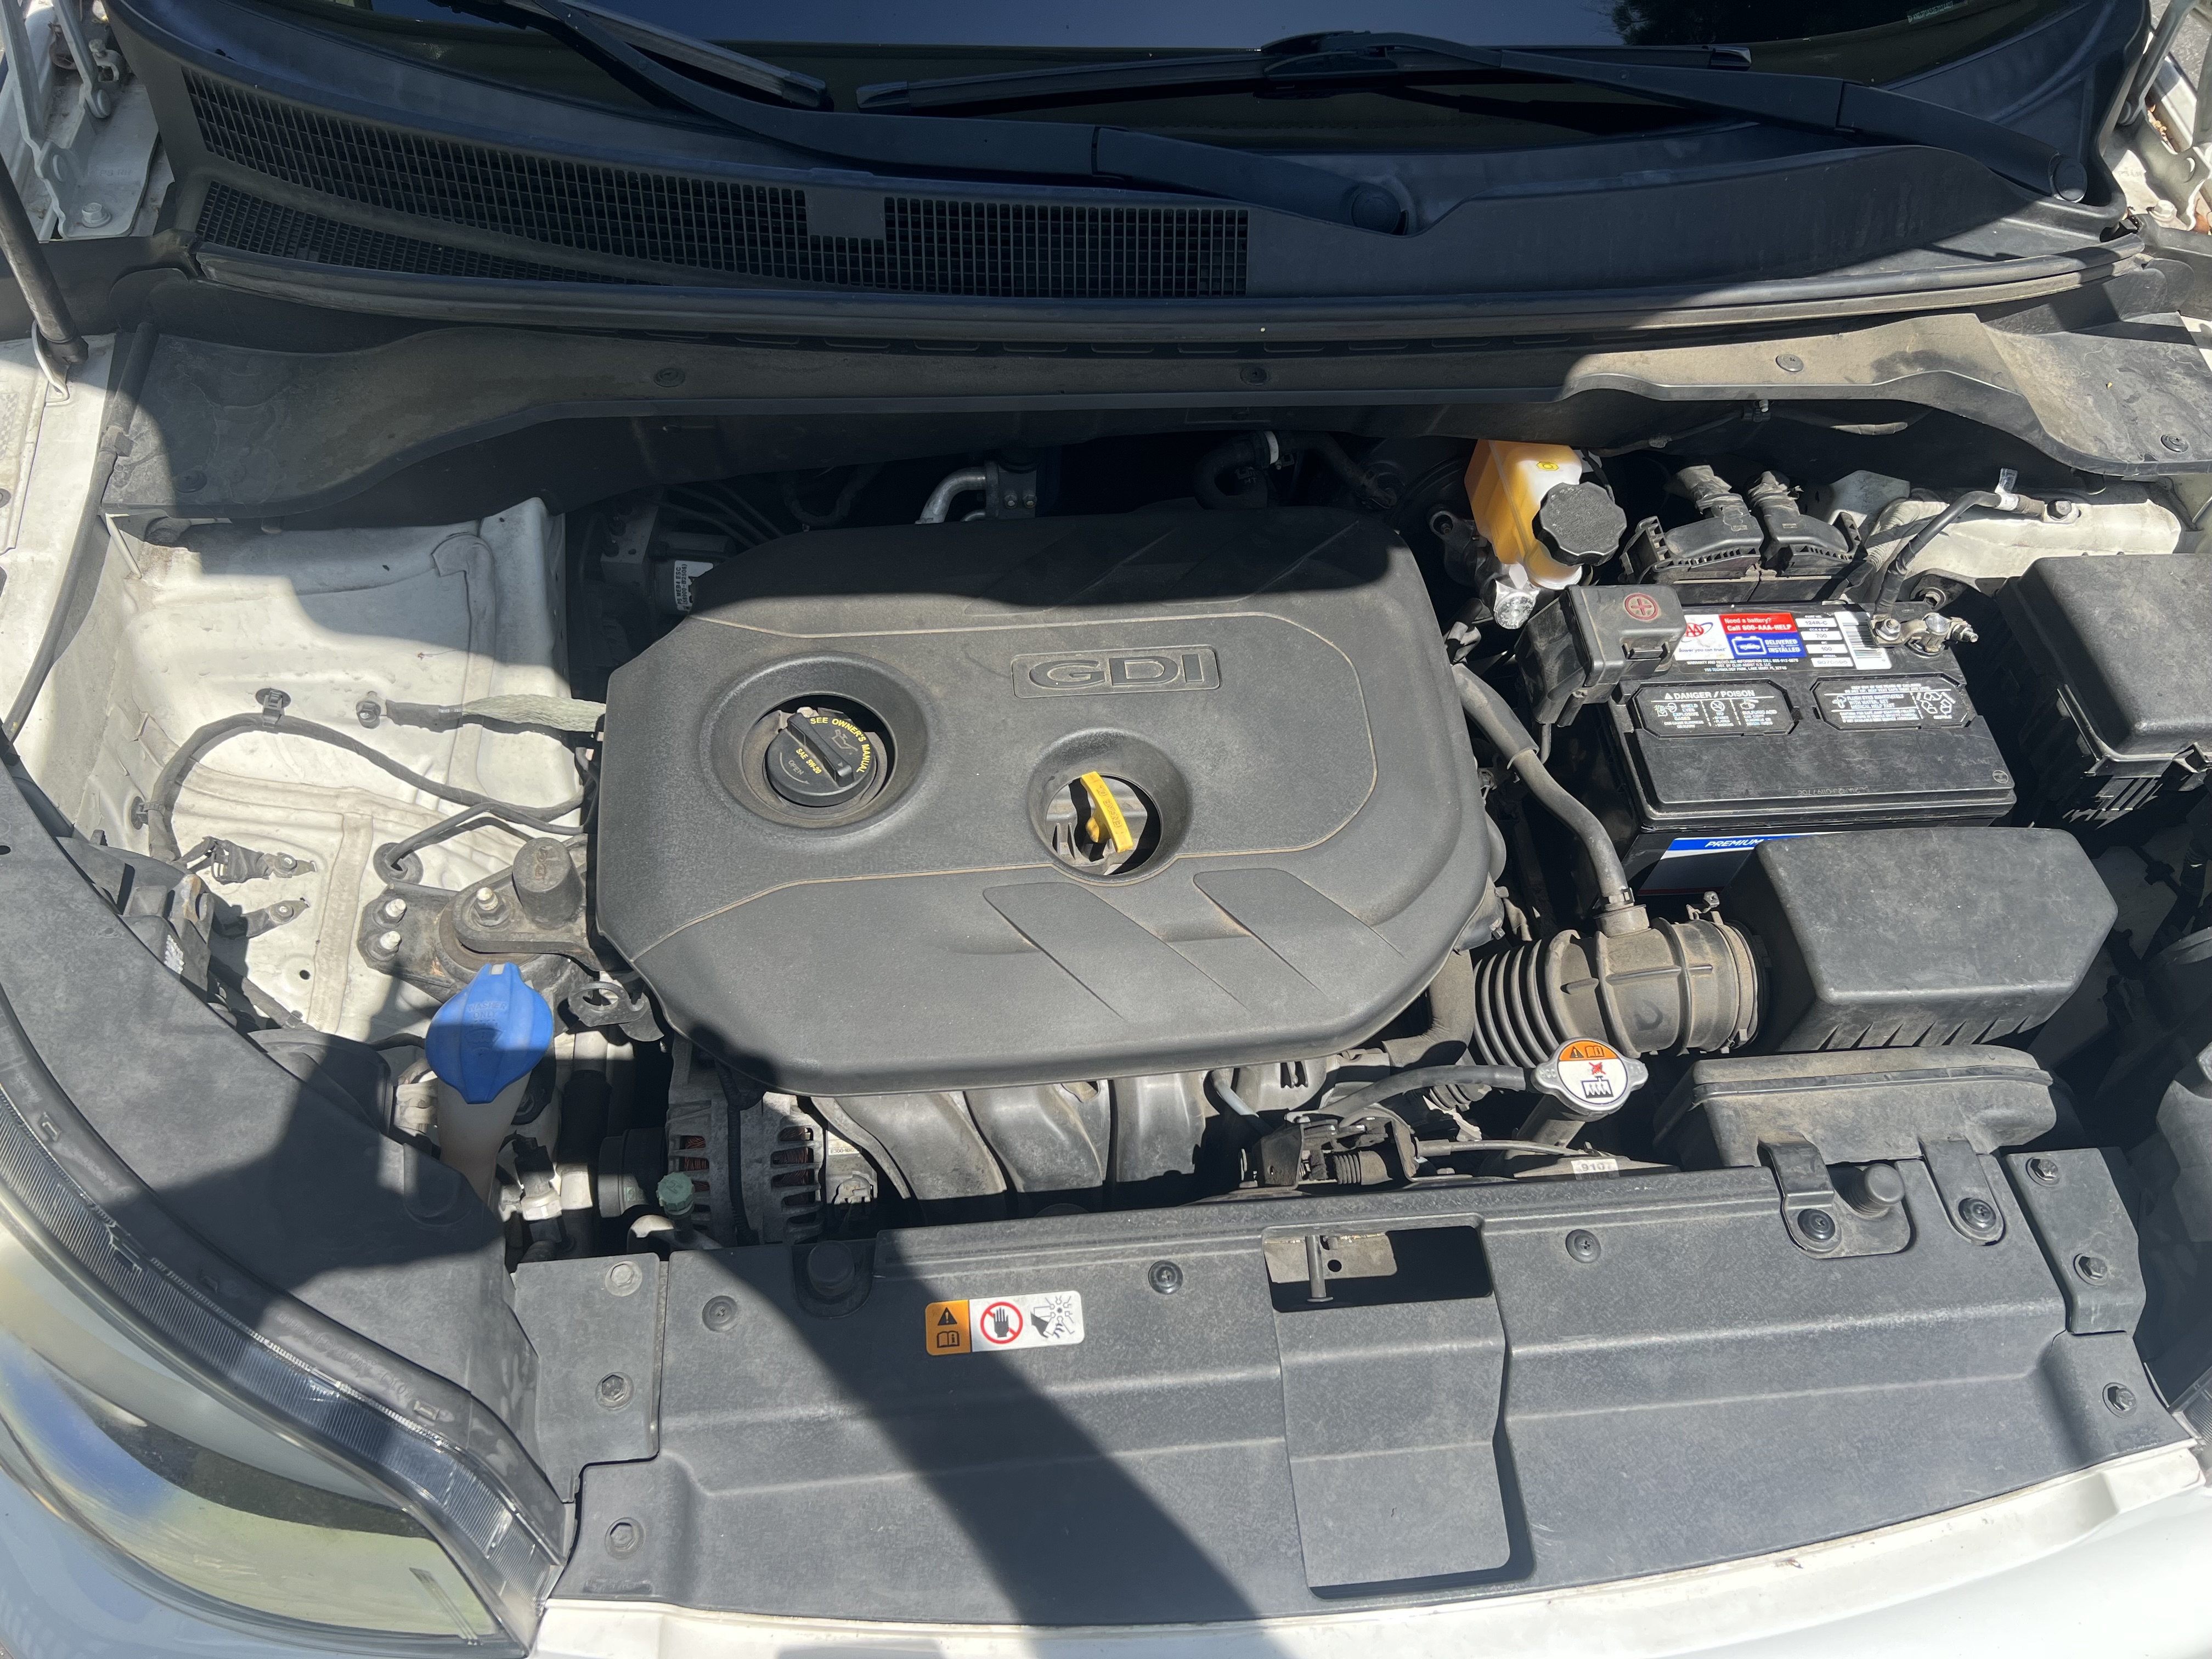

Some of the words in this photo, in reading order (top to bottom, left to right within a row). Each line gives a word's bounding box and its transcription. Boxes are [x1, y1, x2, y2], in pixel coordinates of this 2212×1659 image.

[1029, 653, 1204, 689] GDI
[832, 718, 866, 742] OWNER'S
[856, 744, 871, 773] MANUAL
[788, 759, 804, 775] OPEN
[795, 748, 808, 760] SAE
[806, 759, 822, 774] 5W-20
[1103, 799, 1122, 827] ENGINE
[1705, 839, 1764, 848] PREMIUM
[468, 1002, 506, 1012] WASHER
[666, 1180, 683, 1194] H
